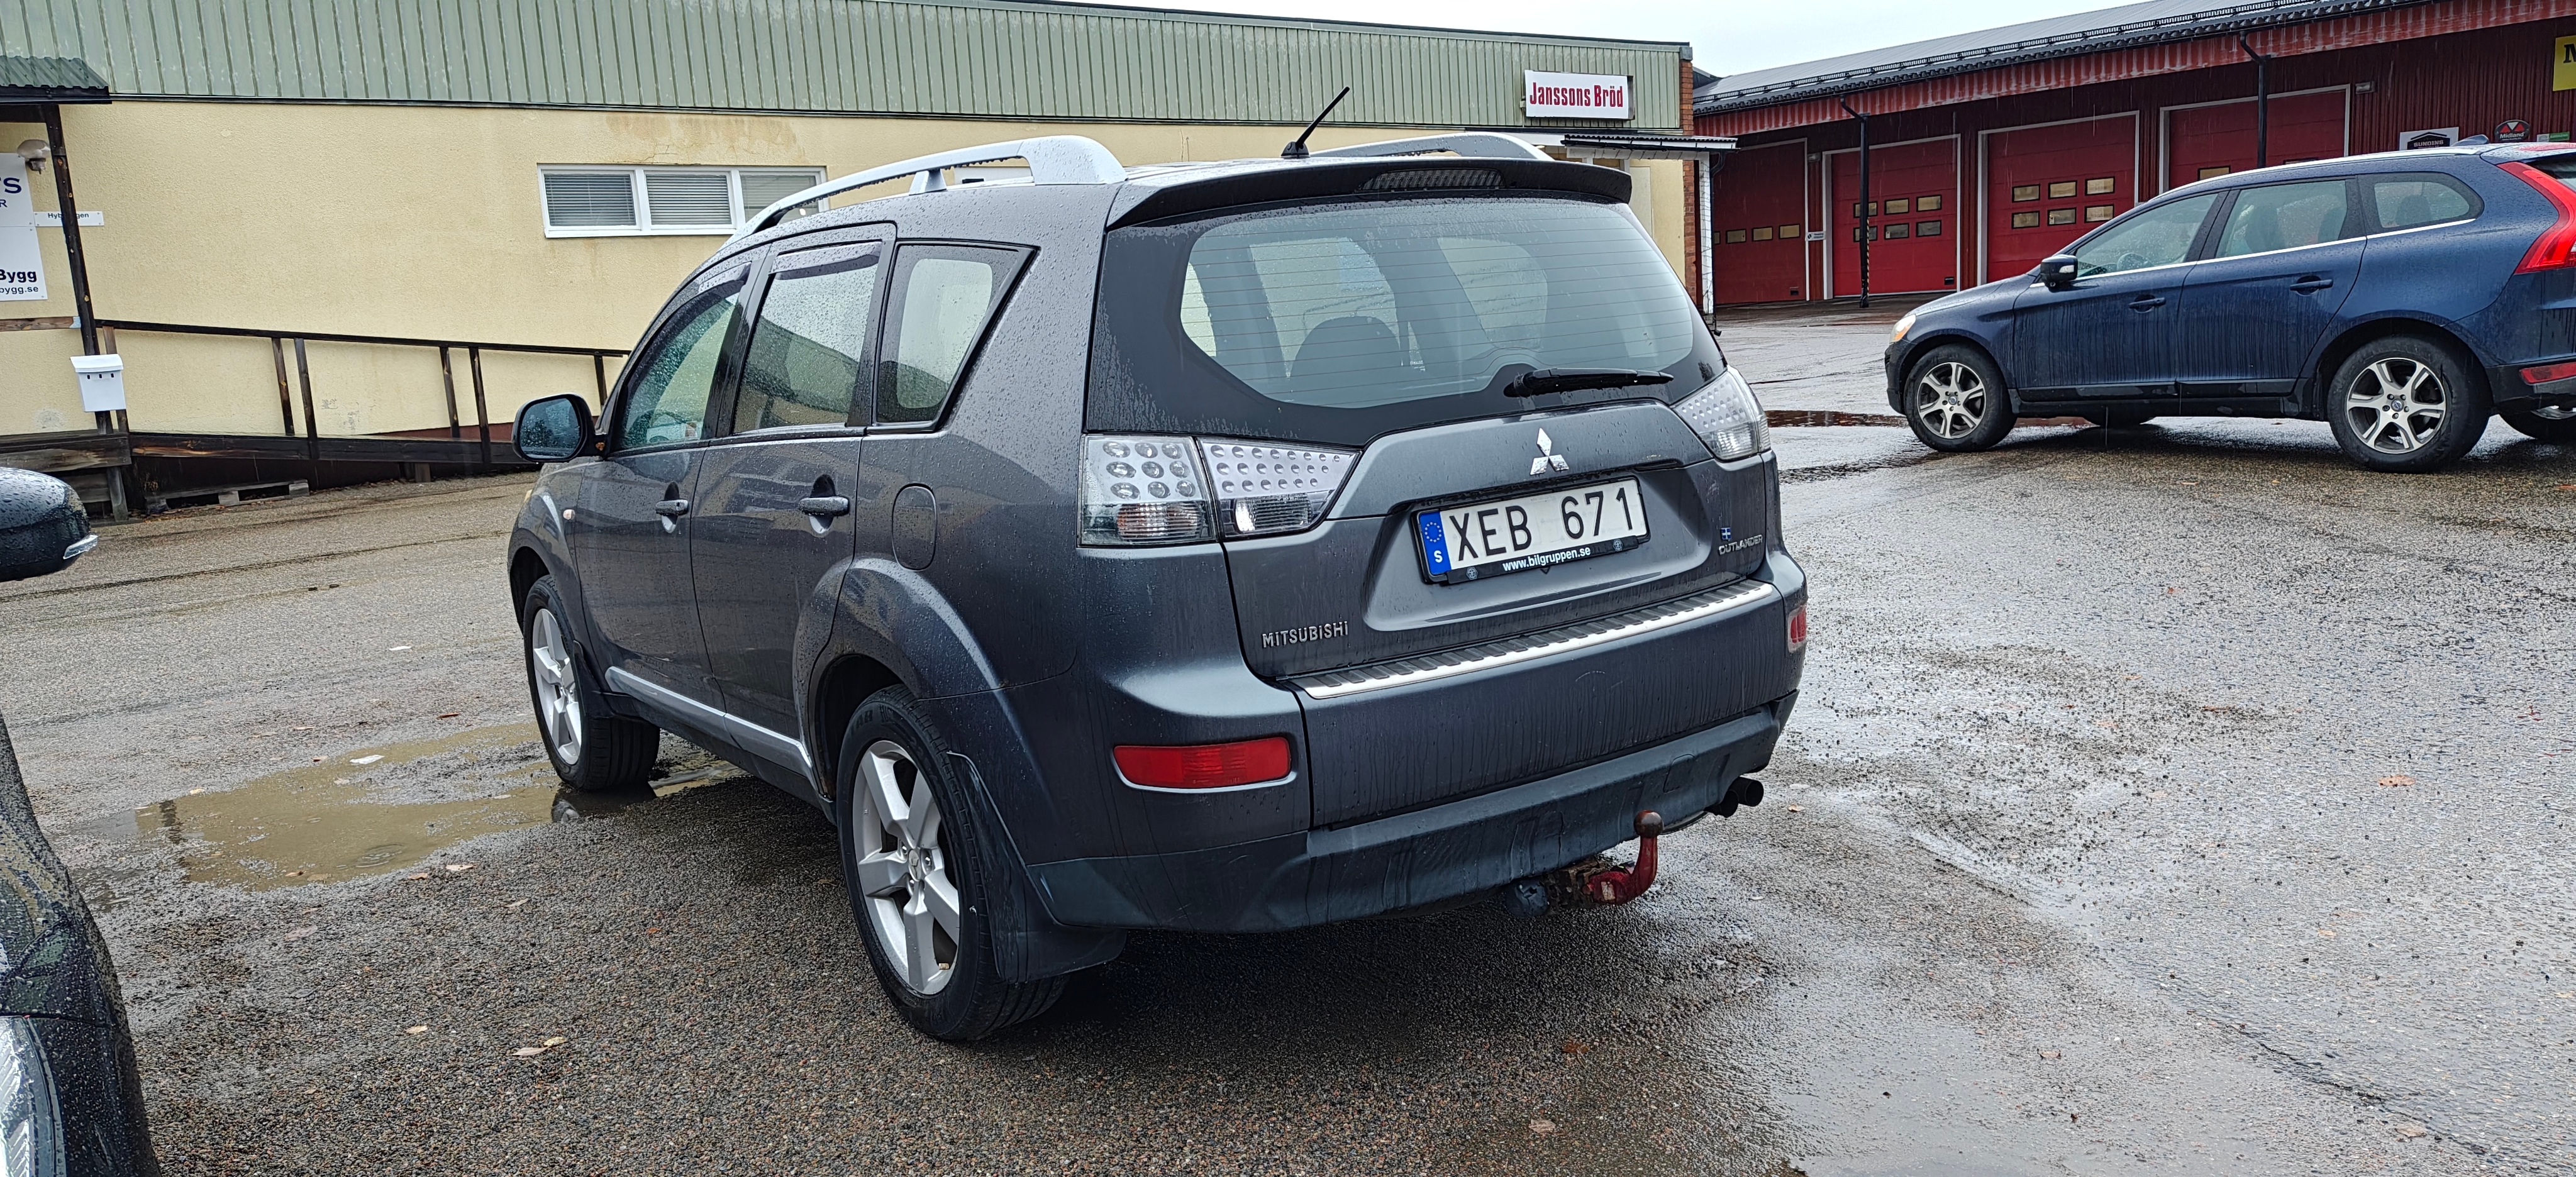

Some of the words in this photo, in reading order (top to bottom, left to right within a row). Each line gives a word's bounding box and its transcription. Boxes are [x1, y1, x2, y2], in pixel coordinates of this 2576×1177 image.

[1530, 82, 1591, 106] Janssons
[1594, 85, 1623, 108] Bröd
[0, 177, 22, 194] S
[1449, 505, 1532, 561] XEB
[1561, 487, 1633, 539] 671
[1433, 550, 1443, 563] S
[1718, 534, 1763, 555] OUTLANDER
[1502, 546, 1591, 572] www.bilgruppen.se
[1262, 621, 1349, 648] MITSUBISHI
